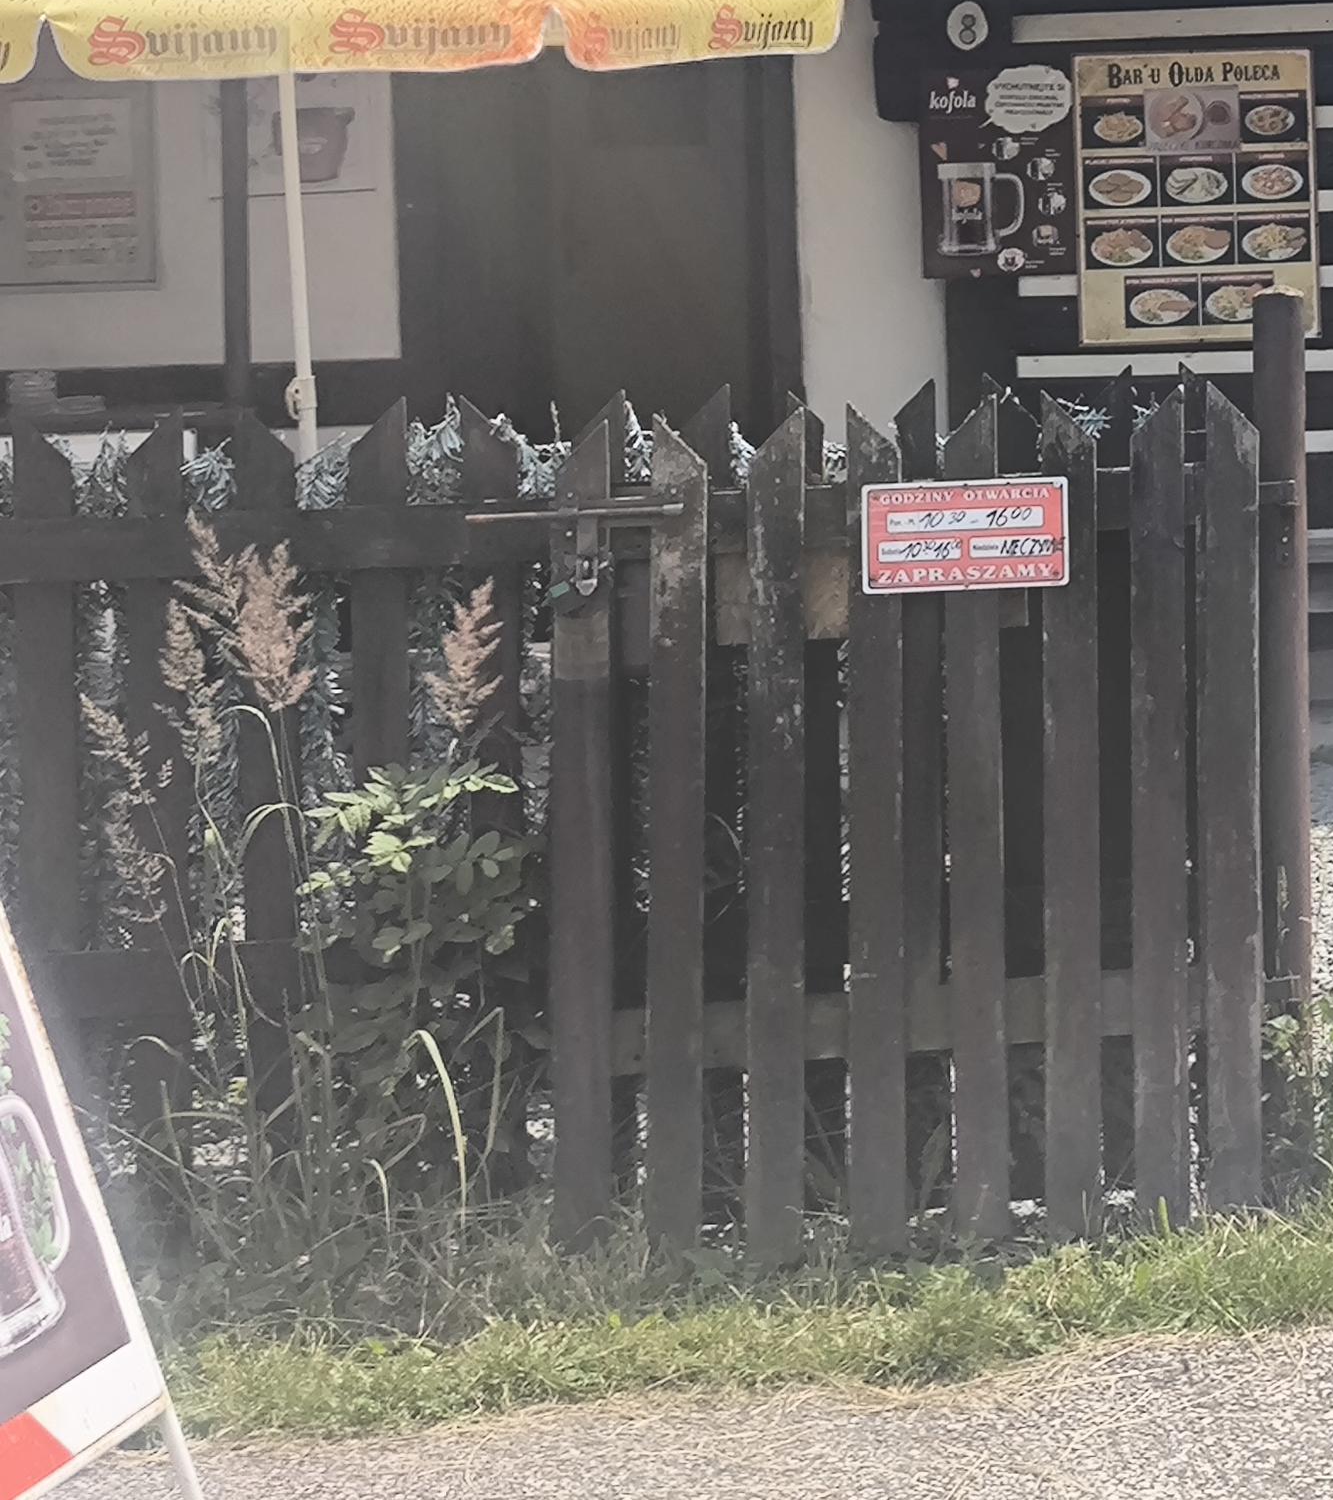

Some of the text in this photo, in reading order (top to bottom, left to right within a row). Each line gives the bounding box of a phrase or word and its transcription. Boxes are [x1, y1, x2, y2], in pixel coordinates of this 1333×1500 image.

[88, 16, 278, 65] Svijany
[328, 8, 511, 55] Svijany
[582, 12, 682, 64] Svijany
[708, 4, 815, 50] Svijany
[959, 14, 976, 44] 8
[1168, 61, 1215, 87] OLDA
[1222, 61, 1281, 82] POLECA
[929, 91, 976, 113] kofola
[879, 487, 1050, 505] GODZINY OTWARCIA
[878, 563, 1055, 585] ZAPRASZAMY
